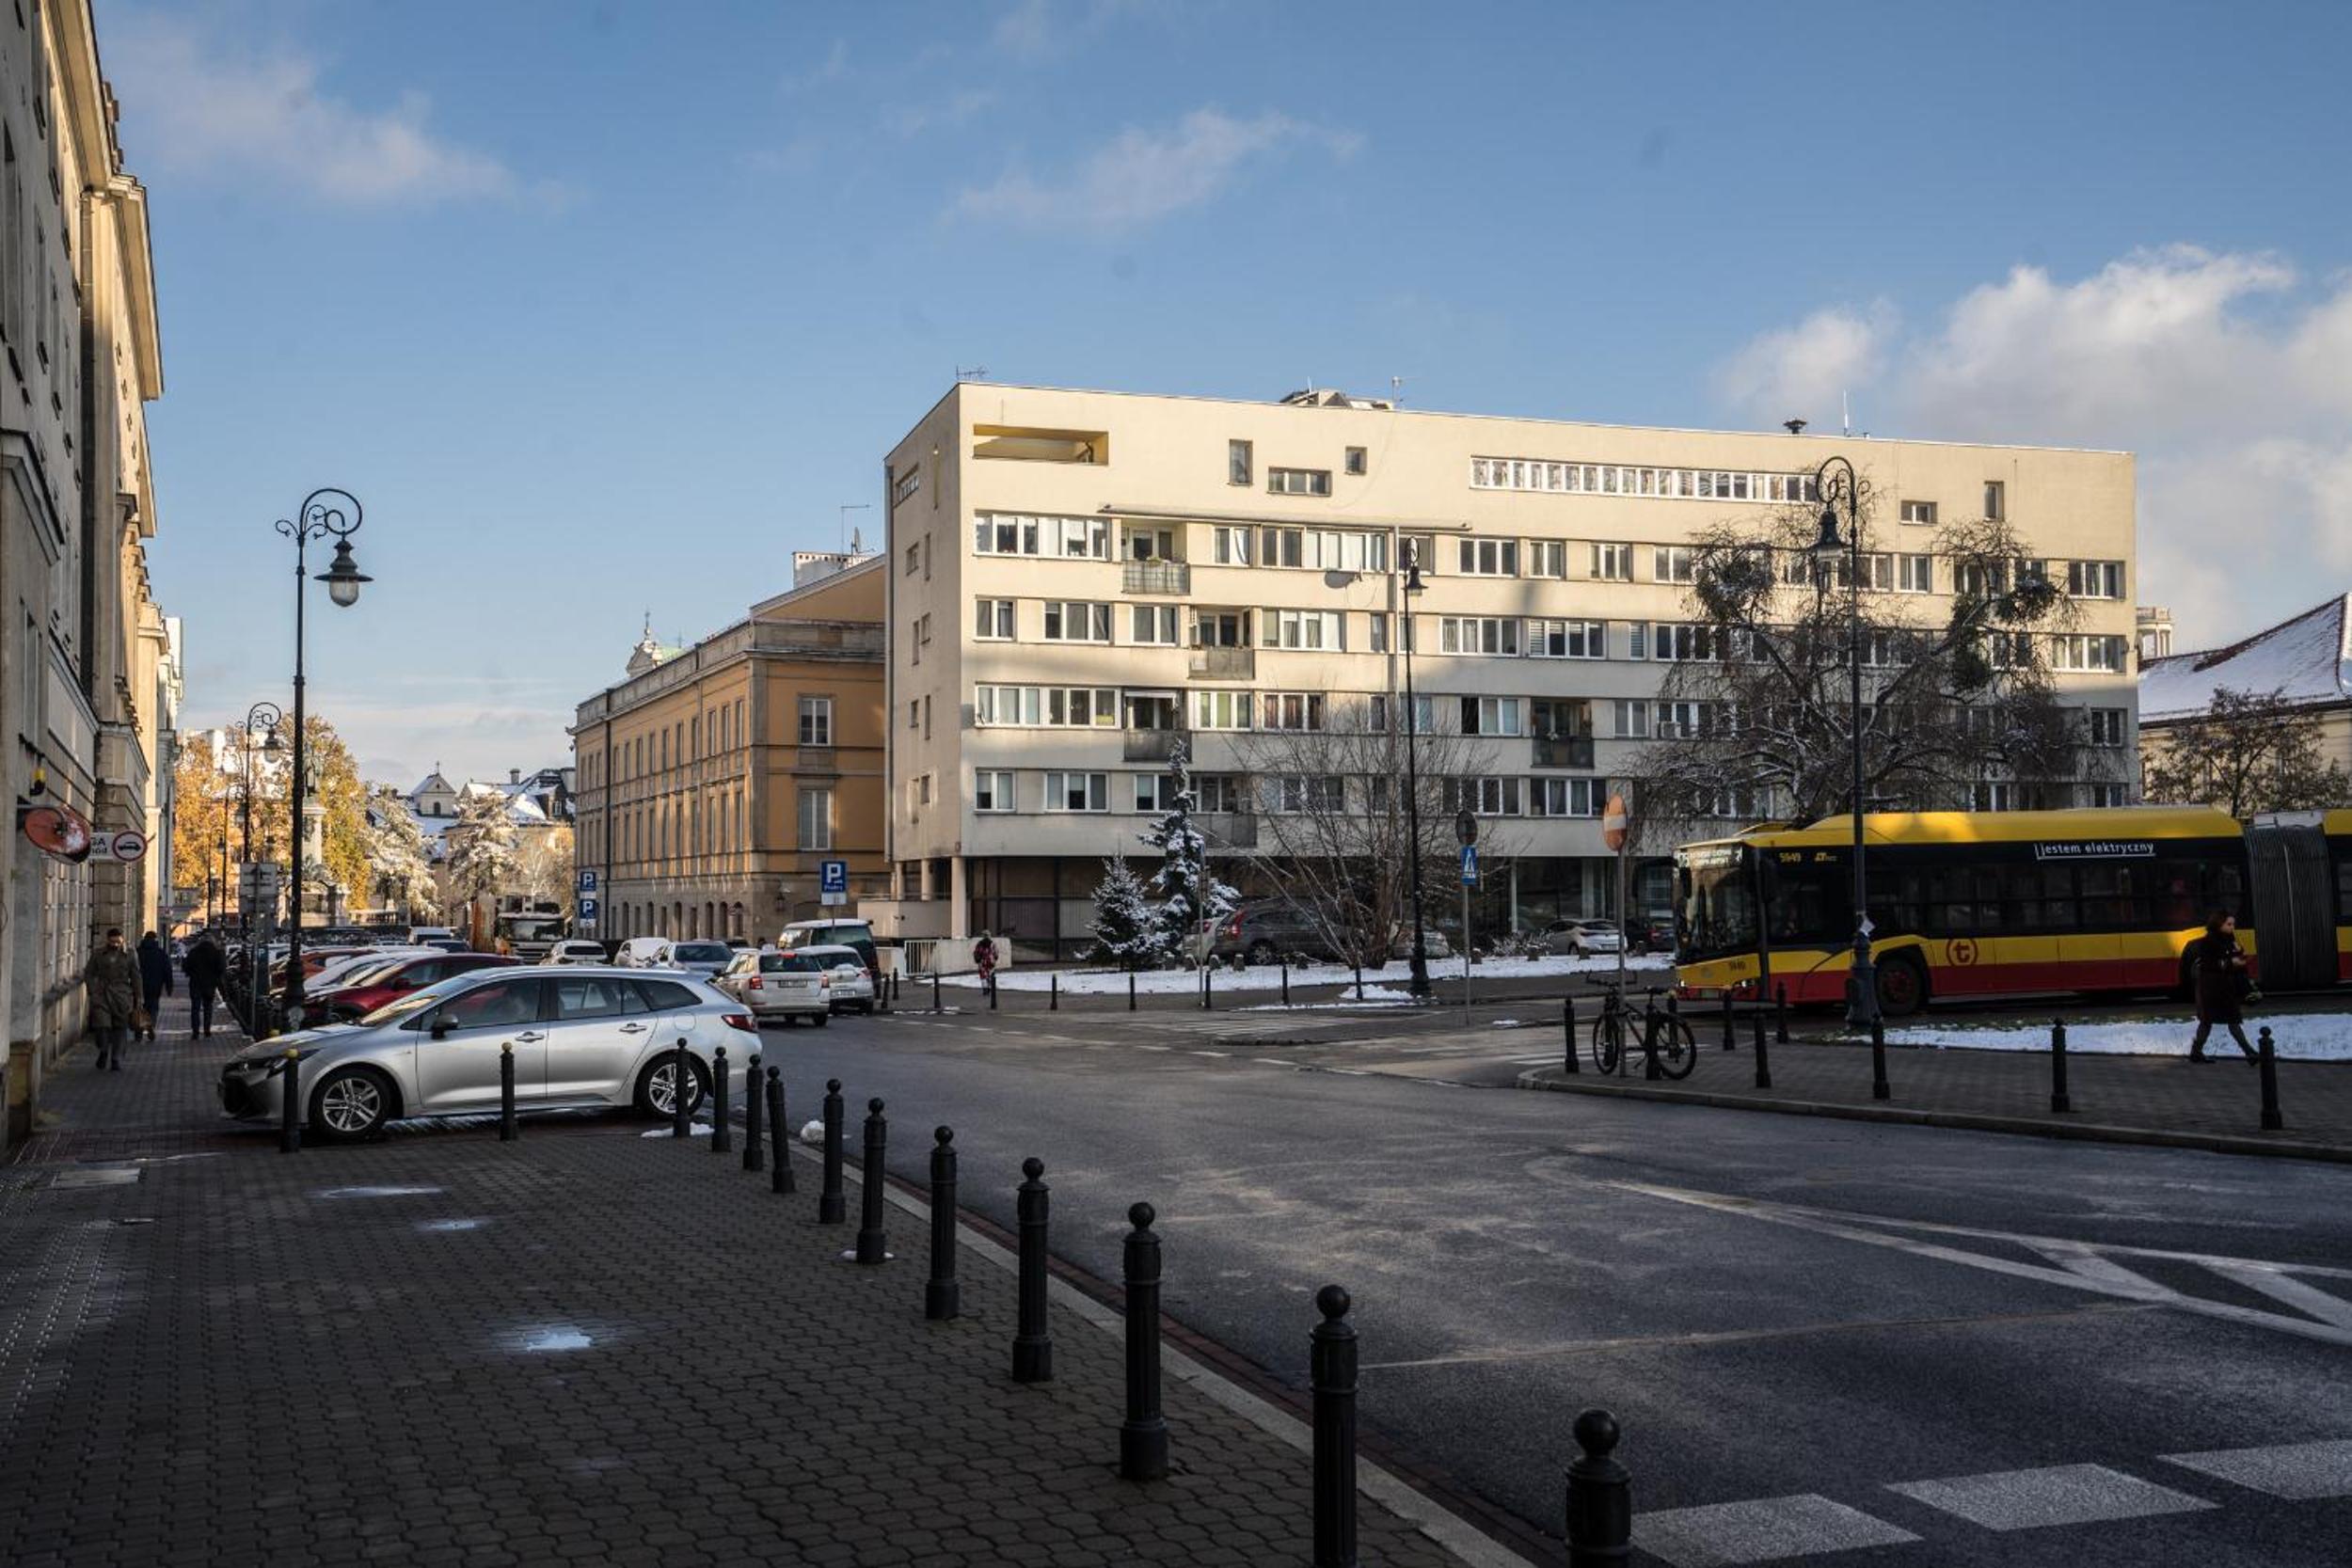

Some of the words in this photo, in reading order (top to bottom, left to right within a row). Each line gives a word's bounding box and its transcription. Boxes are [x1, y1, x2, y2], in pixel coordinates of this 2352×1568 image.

[2085, 842, 2154, 855] elektryczny
[583, 873, 594, 885] P
[827, 863, 842, 883] P
[583, 900, 594, 913] P
